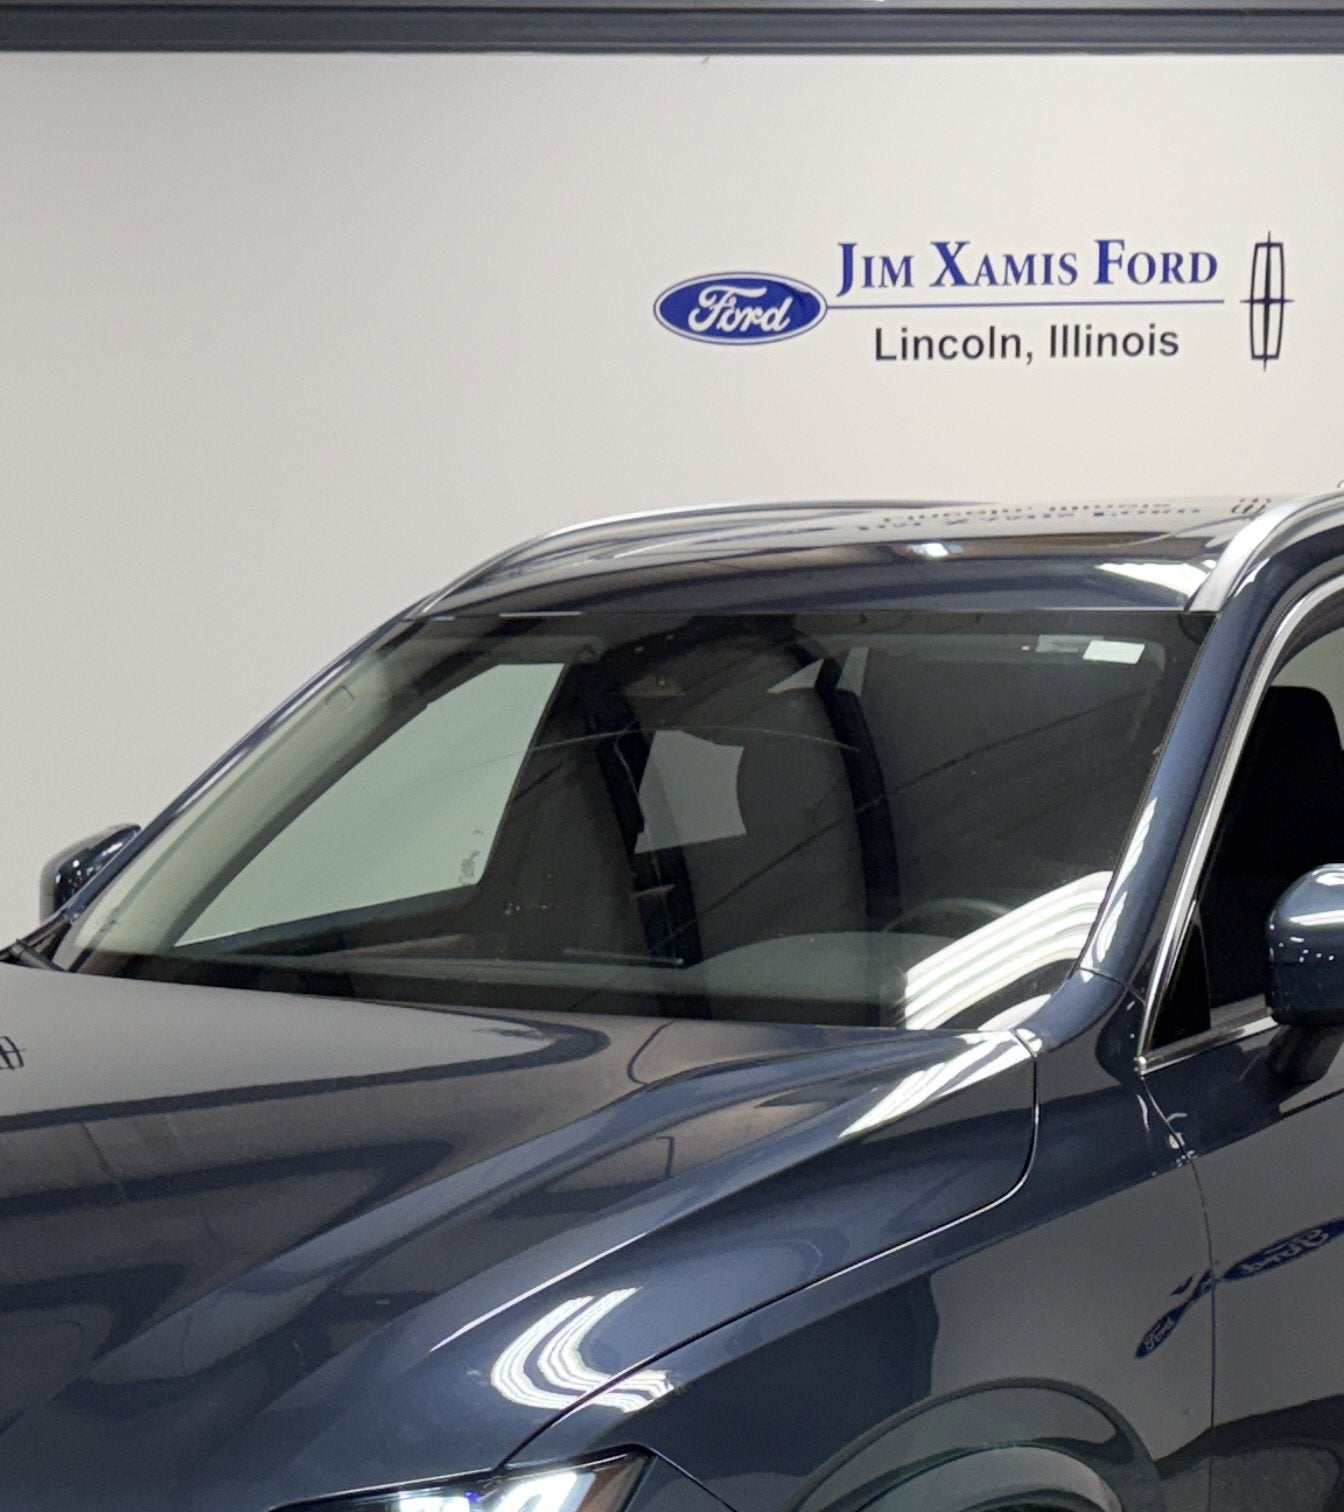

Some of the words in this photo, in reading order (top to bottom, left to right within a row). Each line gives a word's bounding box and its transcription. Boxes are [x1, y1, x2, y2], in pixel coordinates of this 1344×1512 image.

[837, 241, 914, 298] JIM
[929, 240, 1078, 288] XAMIS
[1093, 239, 1218, 285] FORD
[688, 285, 791, 333] Ford
[874, 326, 1034, 366] Lincoln,
[1049, 324, 1179, 358] Illinois
